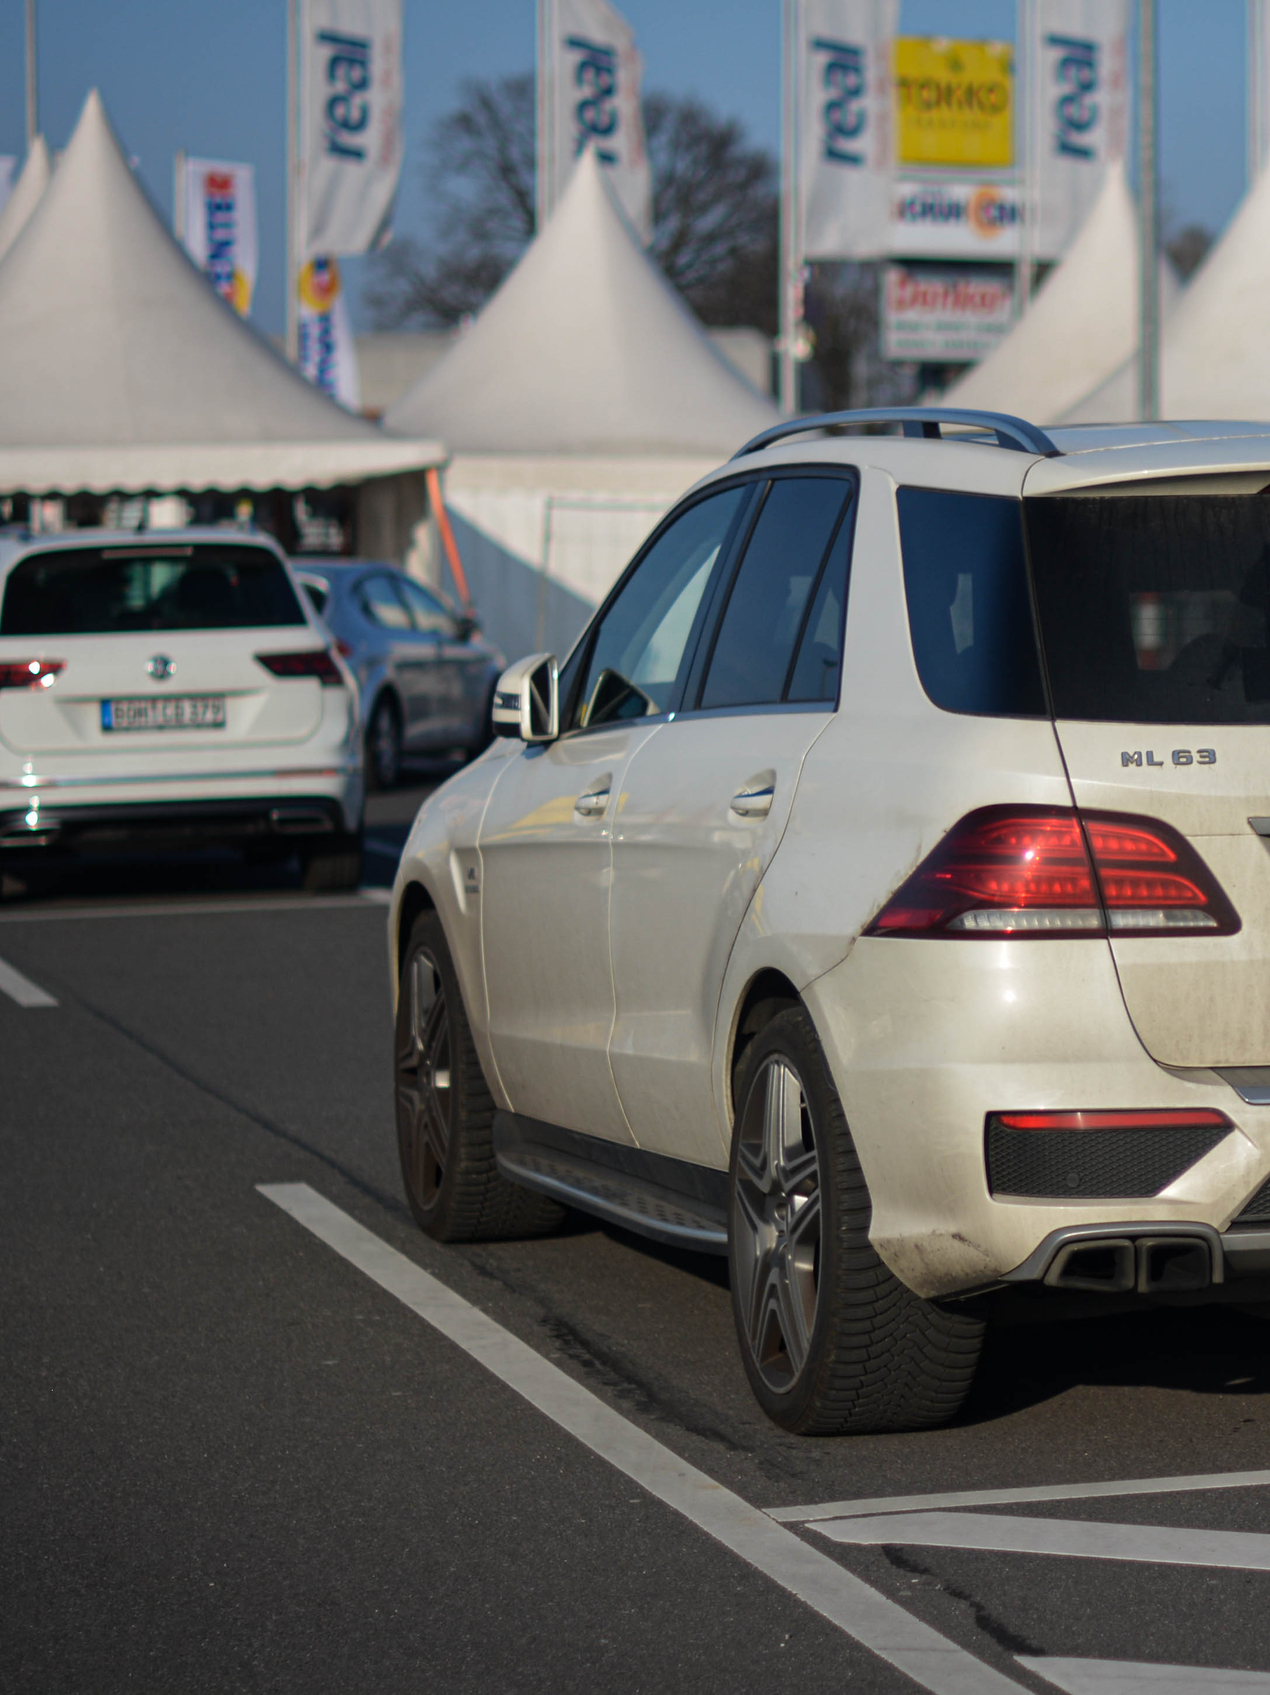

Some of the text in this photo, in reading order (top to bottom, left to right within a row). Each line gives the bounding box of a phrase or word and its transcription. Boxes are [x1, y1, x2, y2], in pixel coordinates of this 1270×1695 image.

[315, 29, 372, 163] real
[810, 36, 866, 167] real
[1046, 33, 1098, 161] real
[1121, 748, 1217, 767] ML 63
